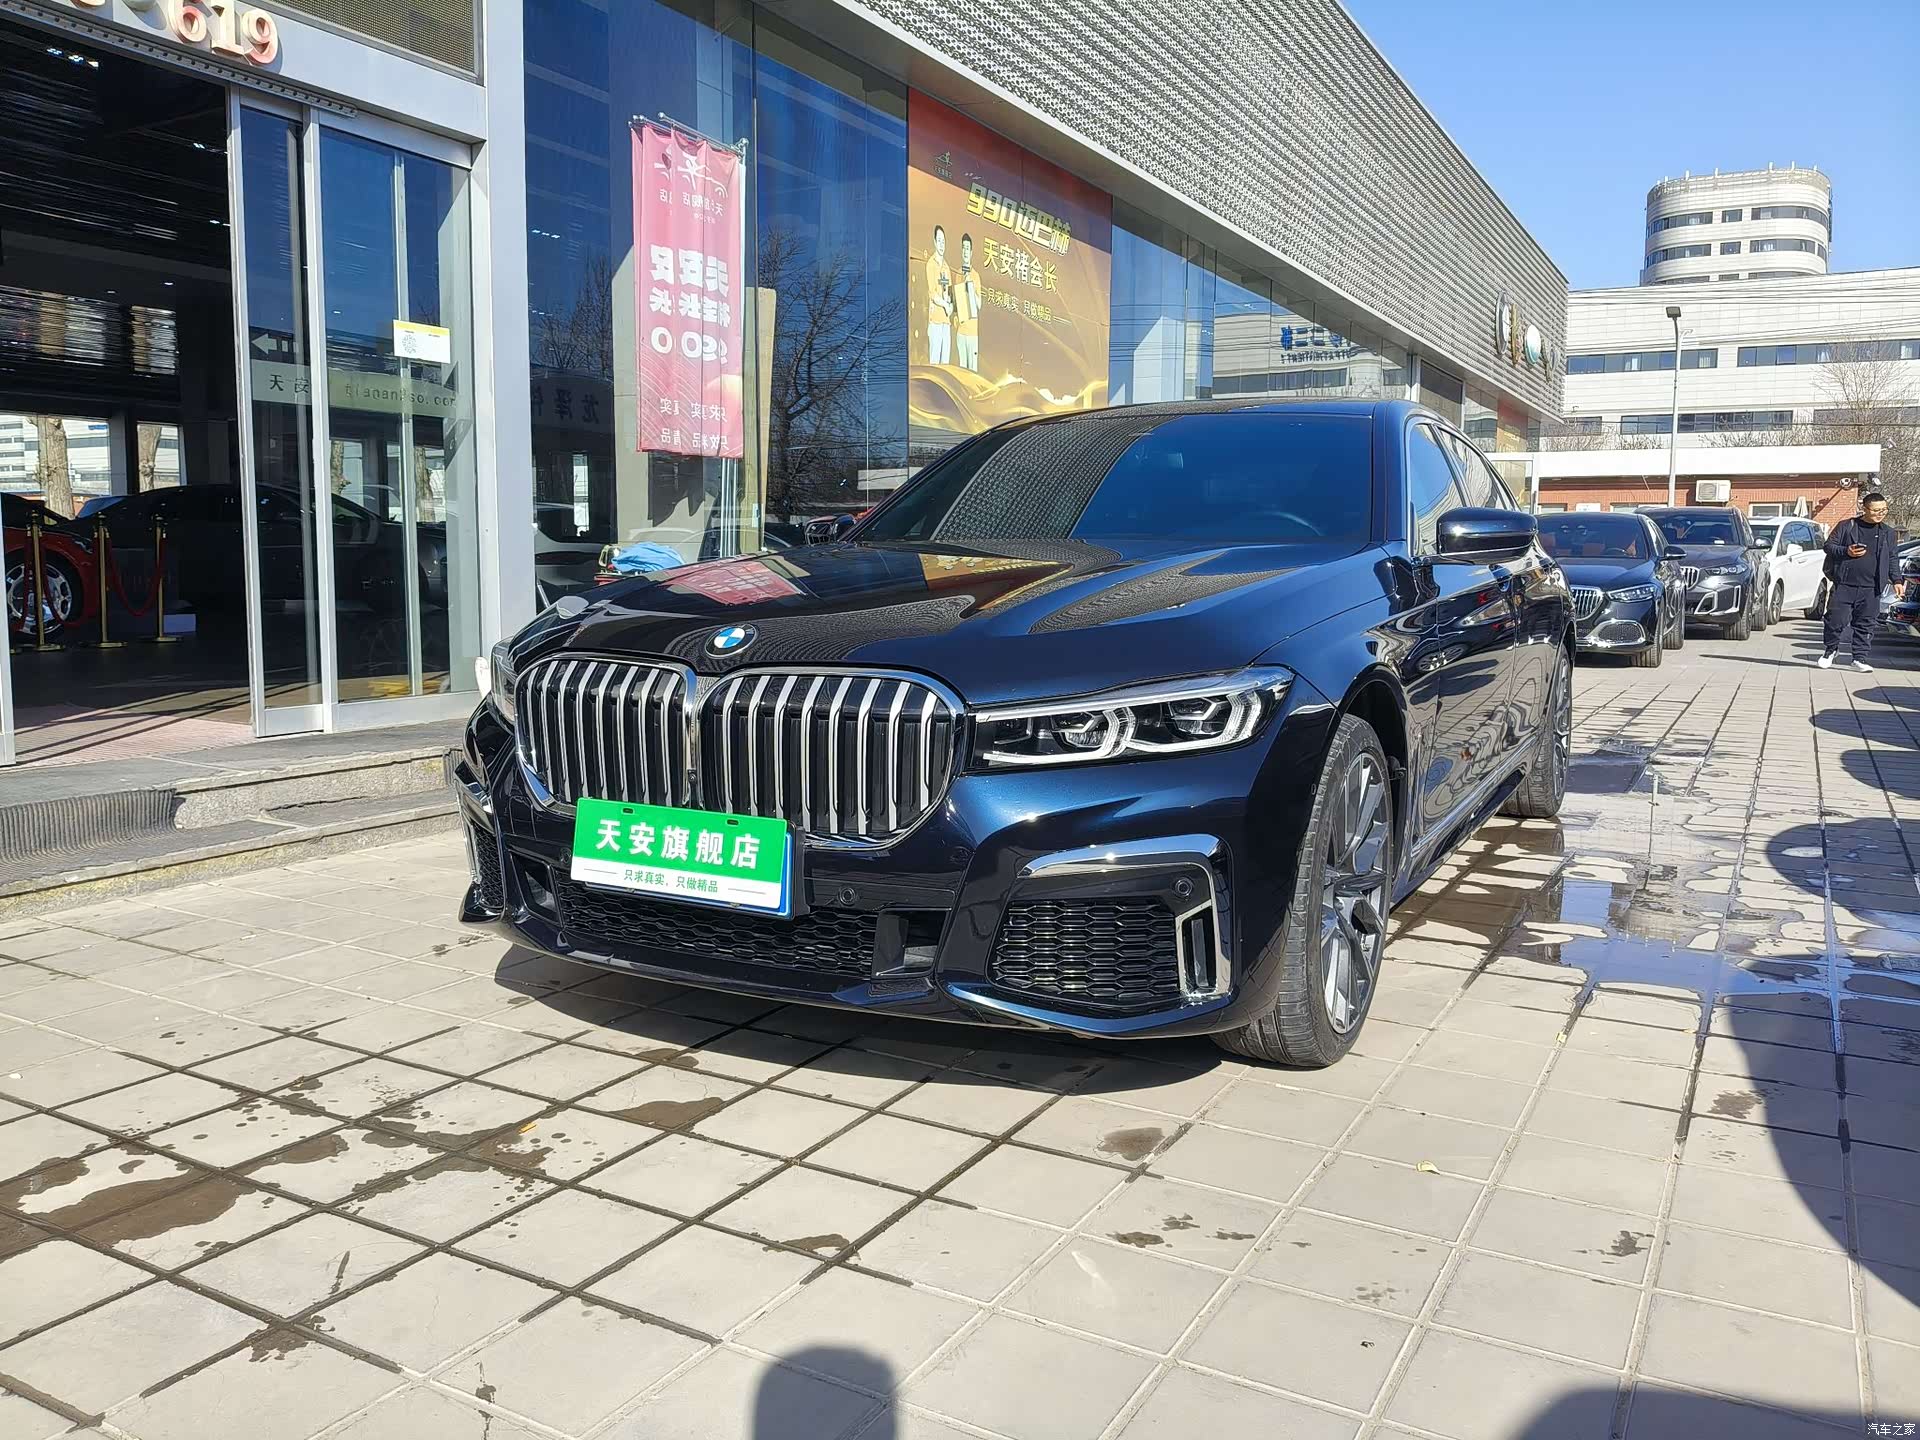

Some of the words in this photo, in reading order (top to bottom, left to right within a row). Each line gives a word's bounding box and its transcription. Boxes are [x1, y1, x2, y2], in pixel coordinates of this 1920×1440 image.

[595, 819, 761, 870] 天安旗舰店
